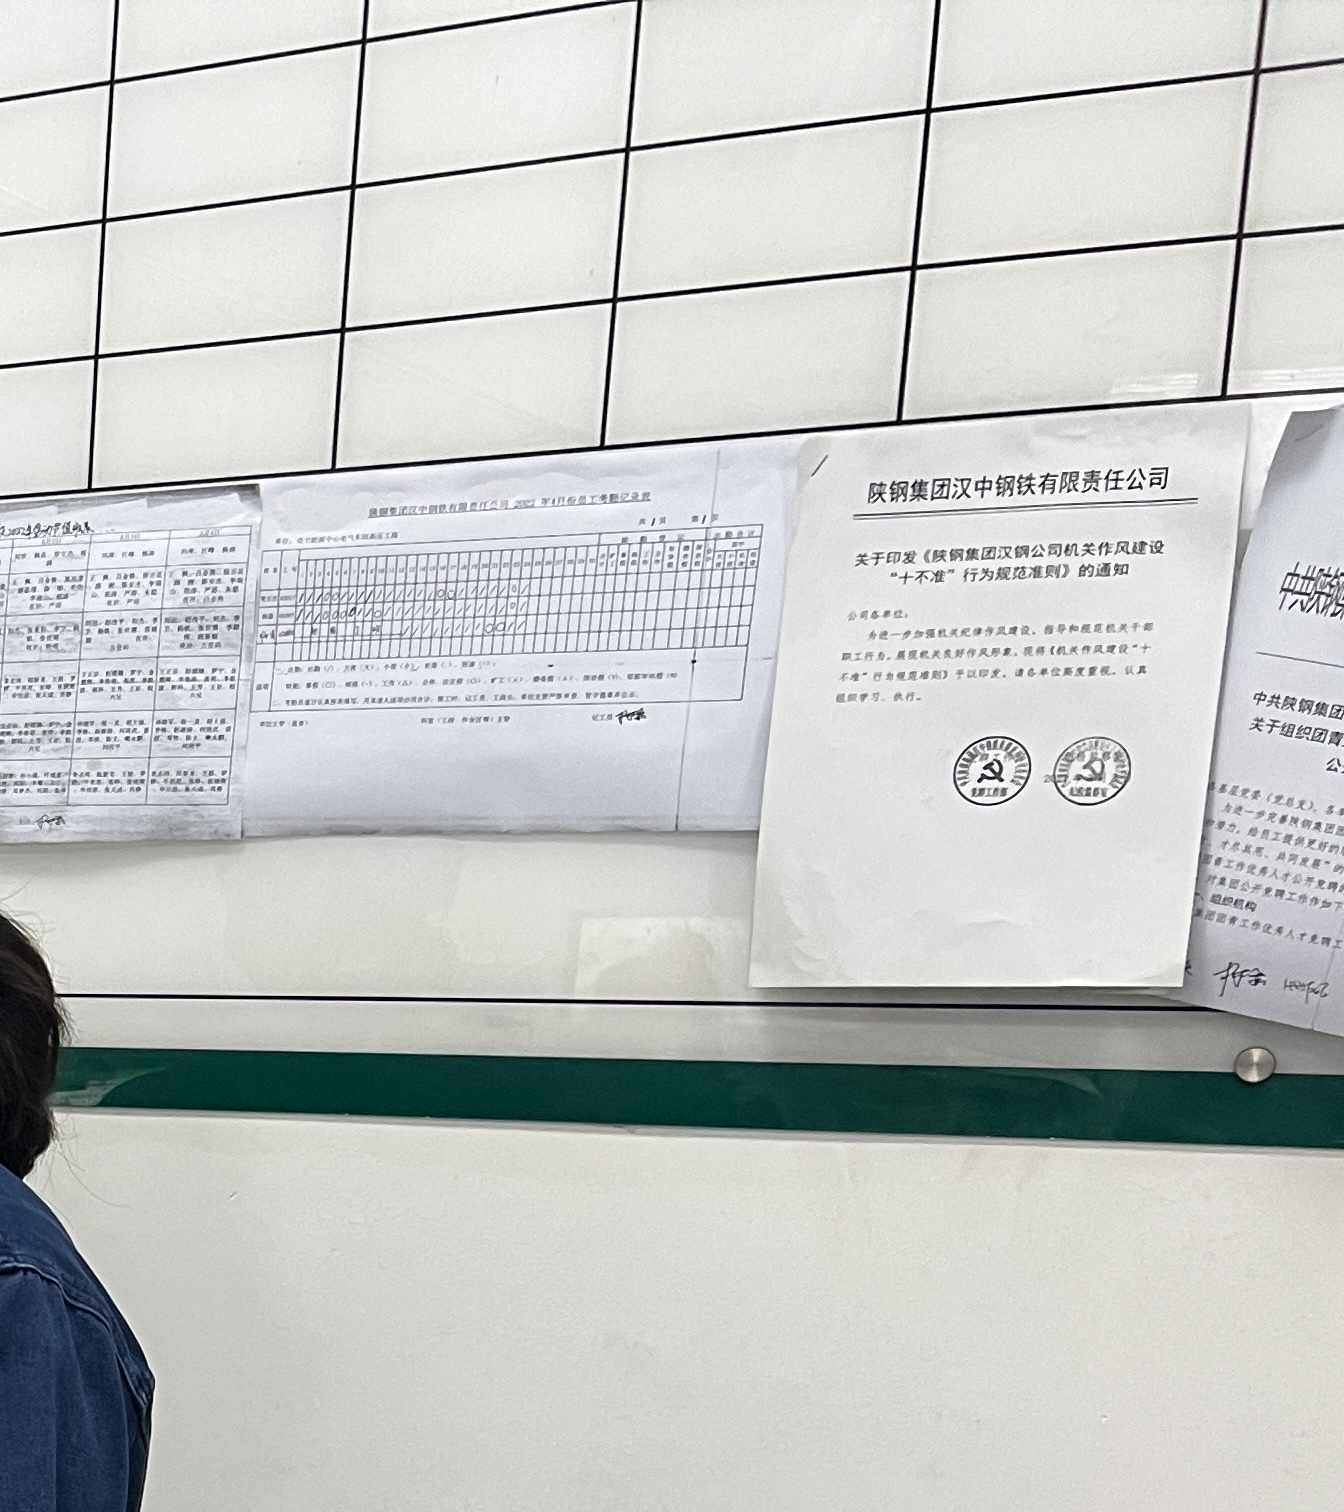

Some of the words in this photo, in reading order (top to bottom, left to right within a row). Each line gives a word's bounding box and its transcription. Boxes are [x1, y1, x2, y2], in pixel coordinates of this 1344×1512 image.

[867, 466, 1169, 504] 陕钢集团汉中钢铁有限责任公司
[855, 539, 1165, 567] 关于印发《陕钢集团汉钢公司机关作风建设
[1248, 715, 1344, 748] 关于组织团青
[1325, 756, 1344, 775] 公
